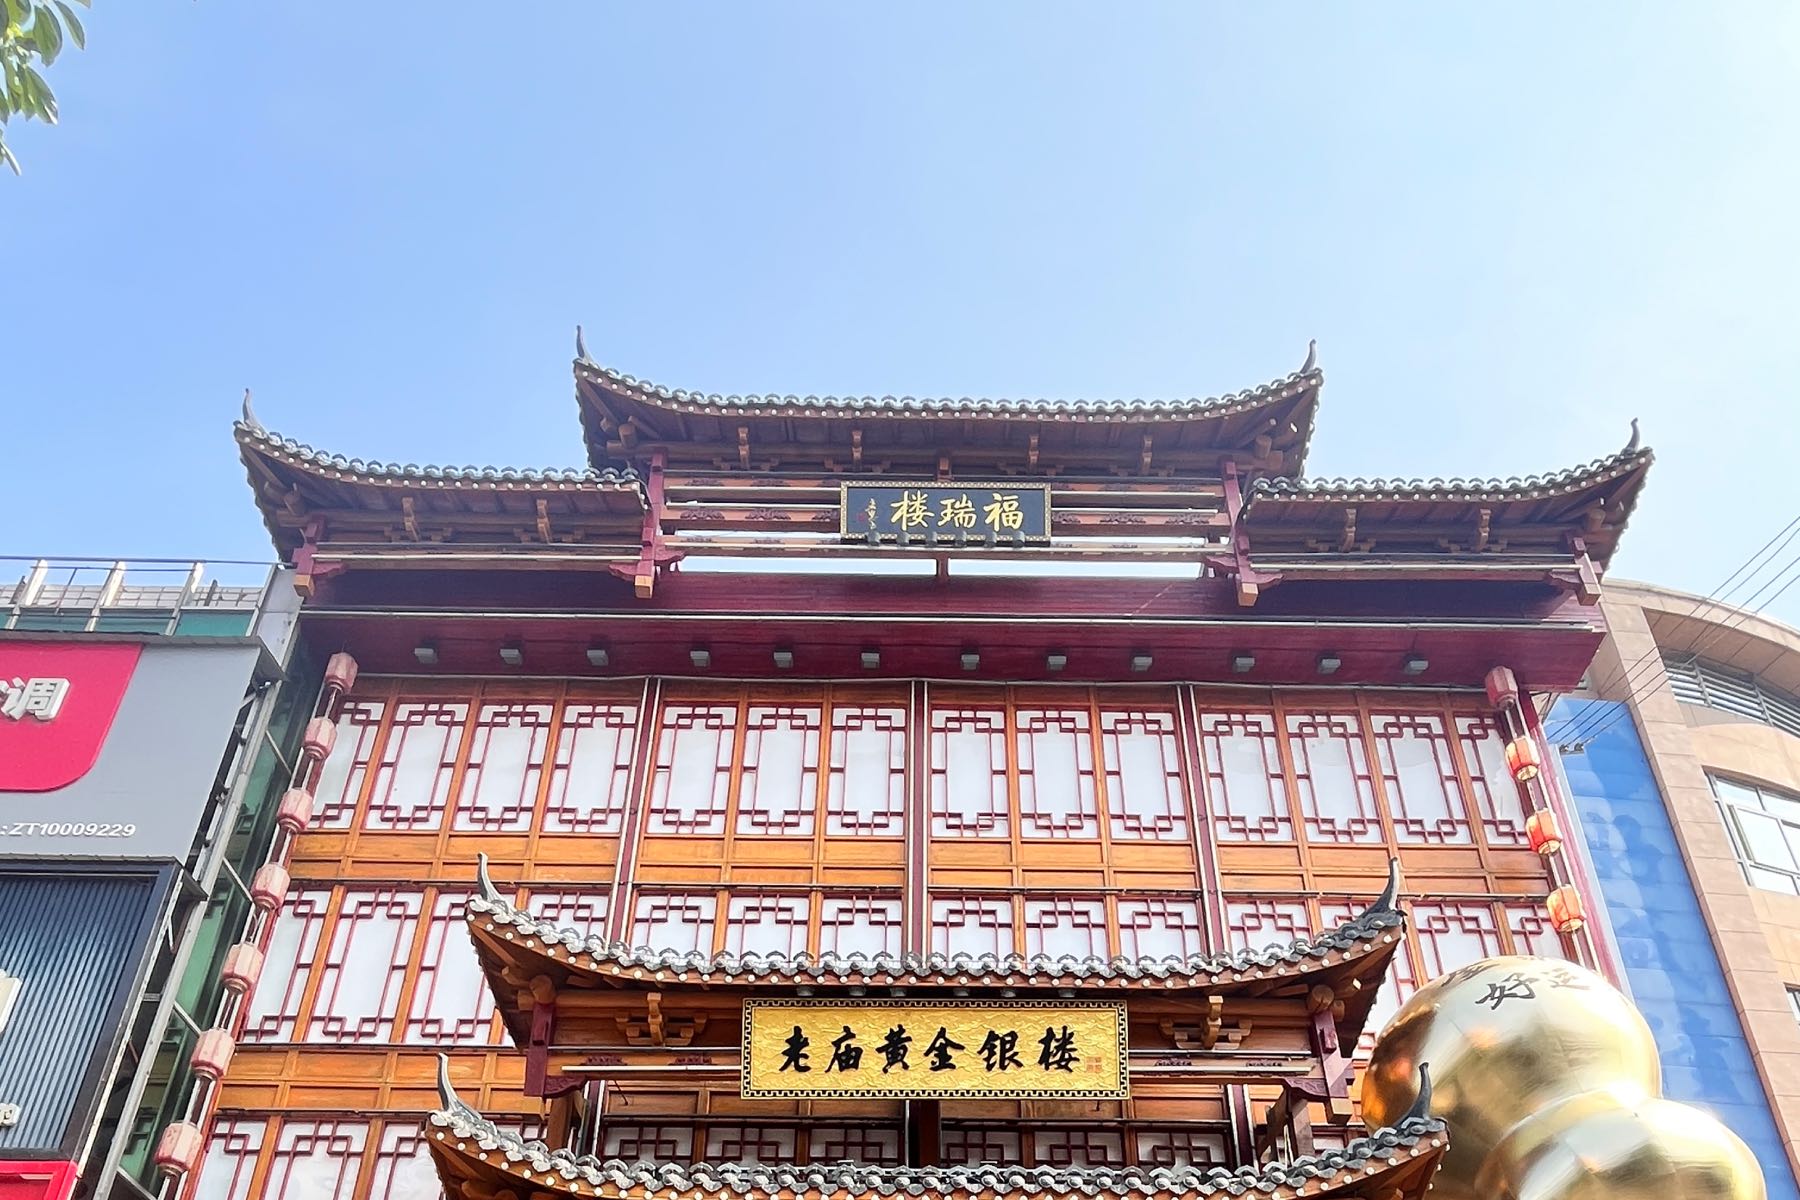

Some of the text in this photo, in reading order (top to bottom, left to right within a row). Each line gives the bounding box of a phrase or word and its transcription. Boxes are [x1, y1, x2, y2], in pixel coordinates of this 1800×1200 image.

[0, 677, 71, 722] 调
[778, 1025, 1080, 1074] 老庙黄金银楼
